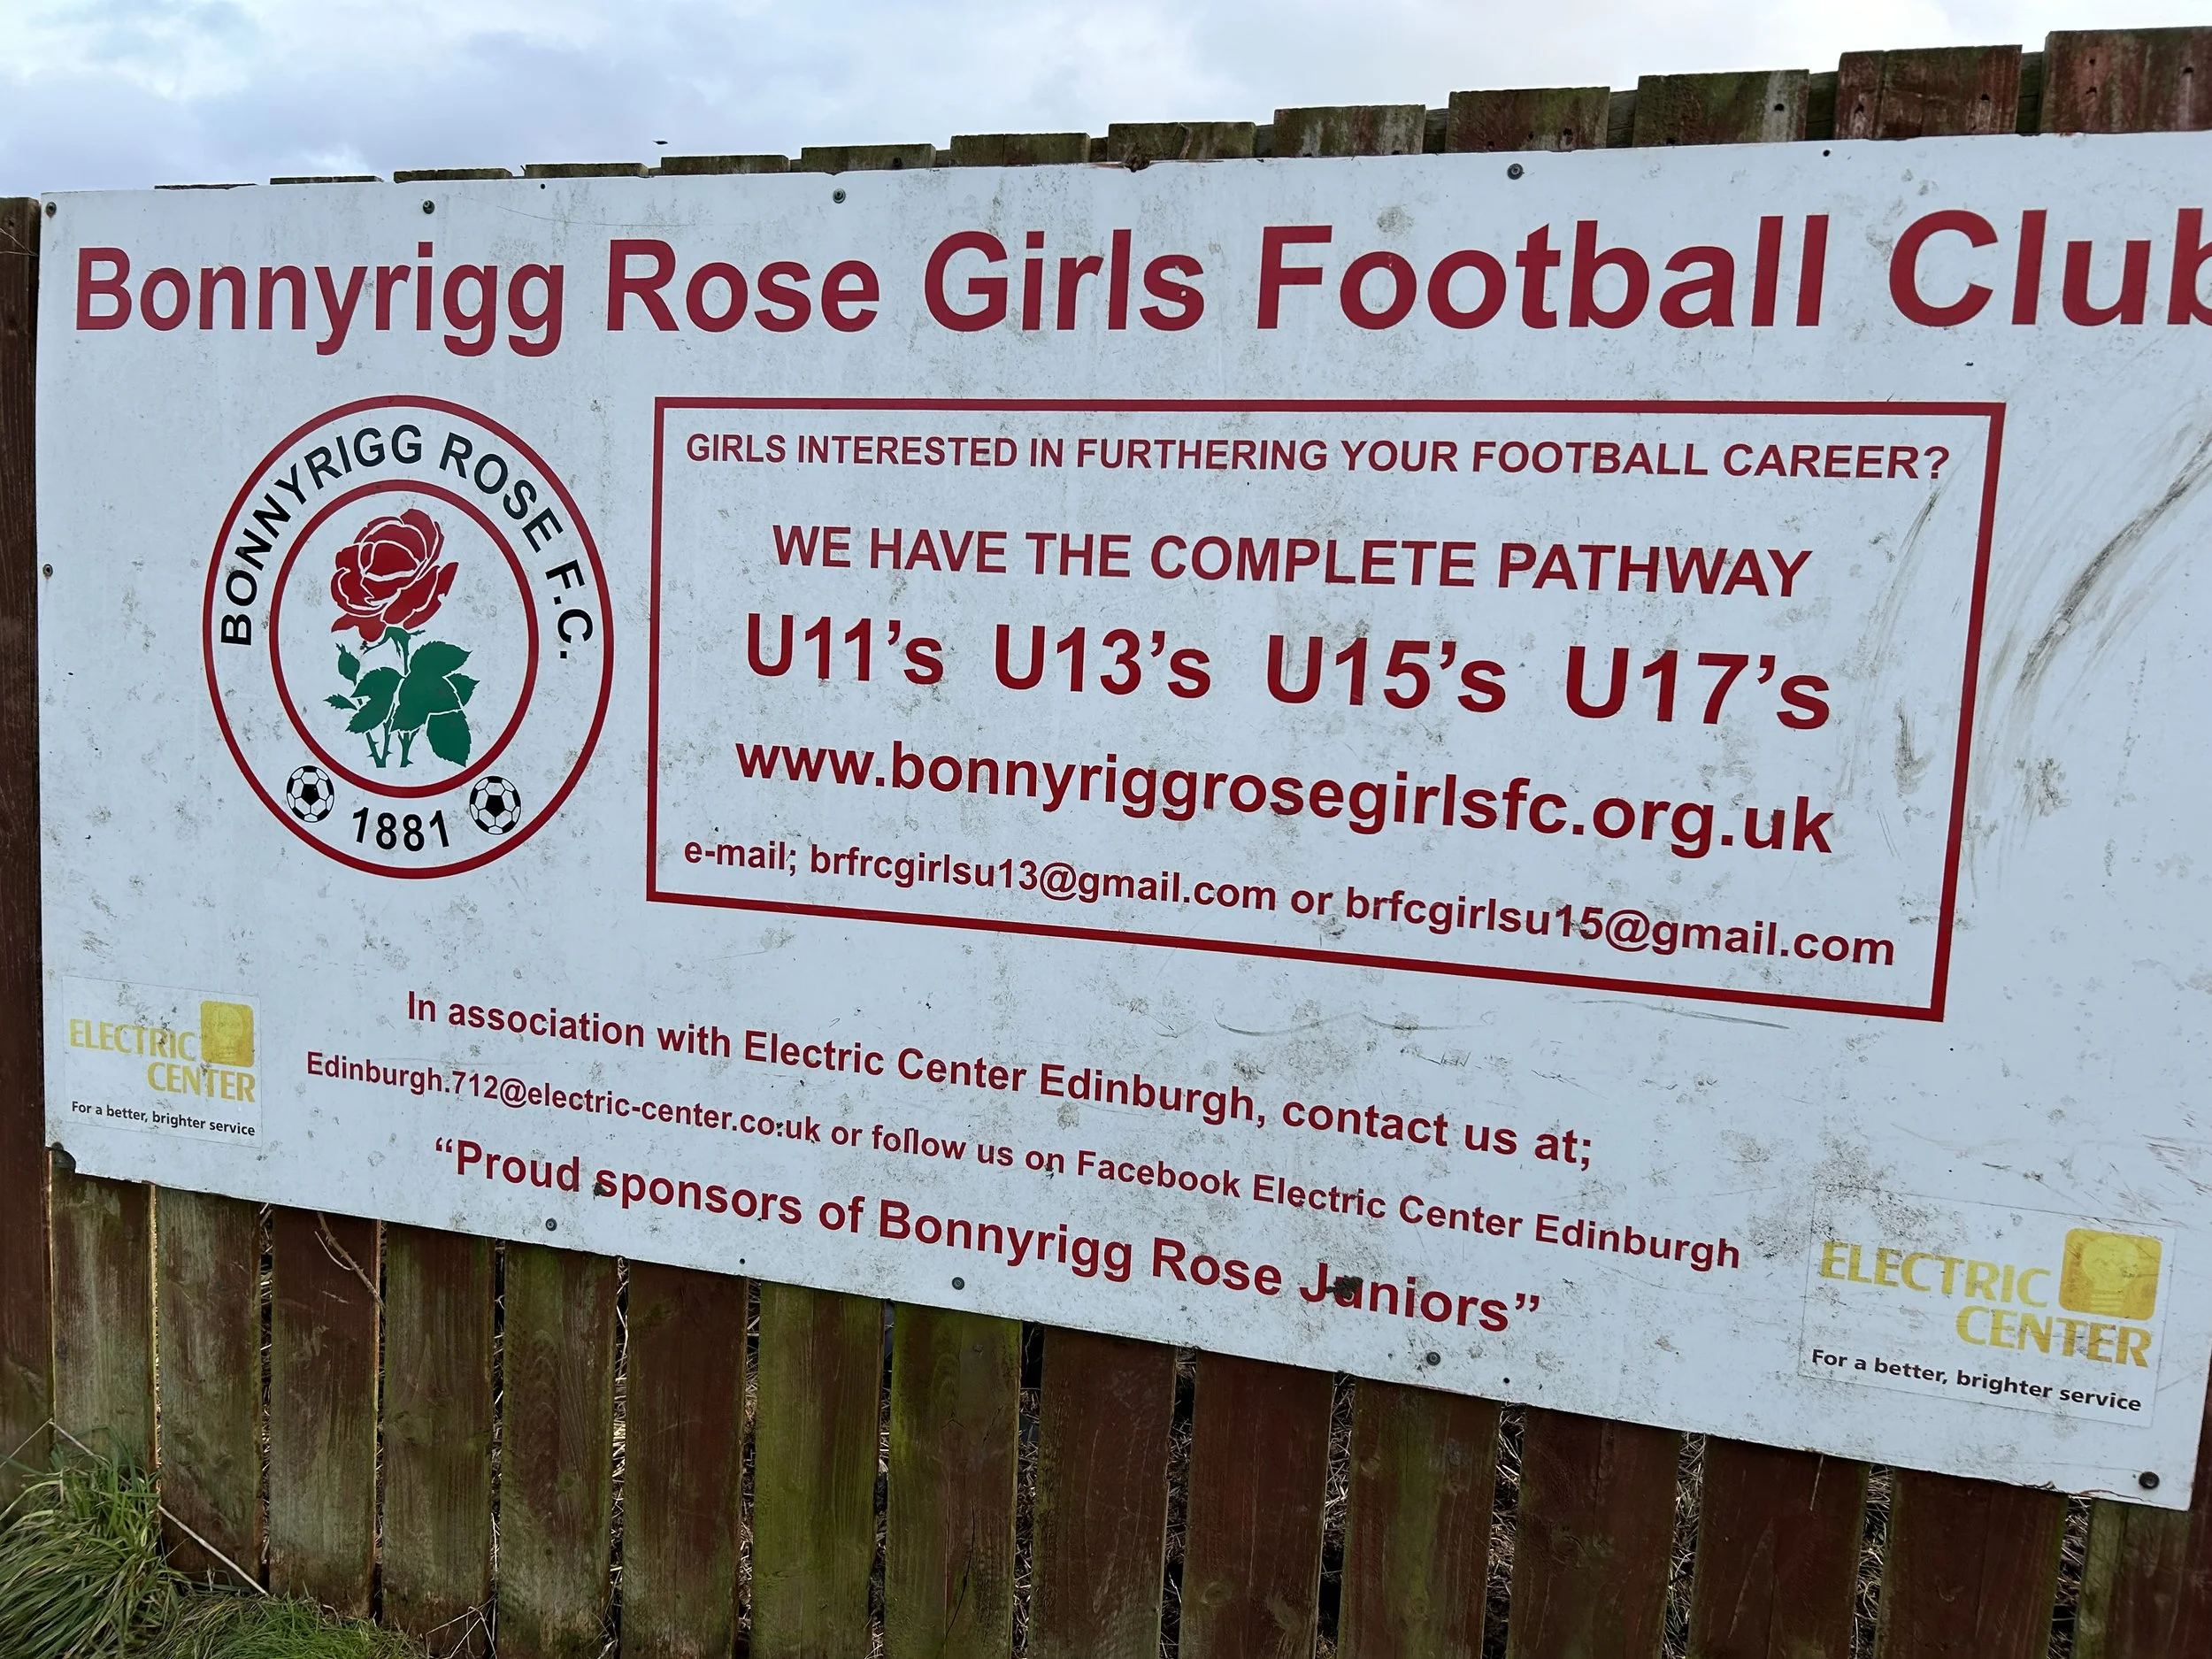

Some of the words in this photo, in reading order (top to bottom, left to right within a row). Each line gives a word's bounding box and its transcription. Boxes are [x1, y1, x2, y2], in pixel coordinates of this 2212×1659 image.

[77, 242, 564, 357] Bonnyrigg
[607, 239, 879, 332] Rose
[925, 228, 1204, 332] Girls
[1257, 214, 1829, 330] Football
[687, 433, 785, 463] GIRLS
[798, 435, 1018, 466] INTERESTED
[1030, 438, 1063, 467] IN
[1077, 438, 1327, 471] FURTHERING
[1342, 440, 1457, 472] YOUR
[1473, 440, 1707, 475] FOOTBALL
[1724, 443, 1949, 479] CAREER?
[221, 425, 423, 648] BONNYRIGG
[439, 432, 564, 554] ROSE
[545, 559, 595, 660] F.C.
[772, 525, 850, 567] WE
[871, 528, 1006, 573] HAVE
[1025, 532, 1131, 578] THE
[1151, 535, 1477, 587] COMPLETE
[1498, 542, 1810, 597] PATHWAY
[352, 807, 451, 852] 1881
[735, 740, 1832, 859] www.bonnyriggrosegirlsfc.org.uk
[684, 841, 795, 873] e-mail;
[810, 844, 1276, 910] brfrcgirlsu13@gmail.com
[1291, 890, 1332, 915] or
[1346, 887, 1894, 965] brfcgirlsu15@gmail.com
[70, 1018, 194, 1062] ELECTRIC
[147, 1062, 256, 1102] CENTER
[408, 991, 436, 1020] In
[449, 1003, 644, 1048] association
[657, 1026, 730, 1056] with
[745, 1030, 883, 1076] Electric
[898, 1048, 1025, 1091] Center
[1040, 1064, 1264, 1125] Edinburgh,
[1282, 1102, 1448, 1147] contact
[1464, 1125, 1517, 1155] us
[1535, 1131, 1590, 1167] at;
[72, 1100, 92, 1115] For
[95, 1105, 103, 1116] a
[106, 1104, 149, 1123] better,
[152, 1110, 206, 1129] brighter
[209, 1121, 256, 1136] service
[307, 1051, 819, 1141] Edinburgh.712@electric-center.co.uk
[831, 1125, 861, 1145] or
[873, 1125, 966, 1159] follow
[978, 1146, 1013, 1166] us
[1025, 1150, 1064, 1172] on
[1077, 1150, 1240, 1197] Facebook
[1253, 1174, 1384, 1218] Electric
[1399, 1195, 1522, 1237] Center
[1535, 1213, 1739, 1272] Edinburgh
[595, 1169, 802, 1225] sponsors
[818, 1195, 864, 1233] of
[879, 1199, 1132, 1283] Bonnyrigg
[1152, 1238, 1282, 1295] Rose
[1821, 1240, 2049, 1307] ELECTRIC
[1955, 1305, 2152, 1368] CENTER
[1811, 1348, 1848, 1371] For
[1854, 1356, 1867, 1371] a
[1874, 1357, 1949, 1386] better,
[1956, 1369, 2054, 1399] brighter
[2059, 1387, 2142, 1413] service
